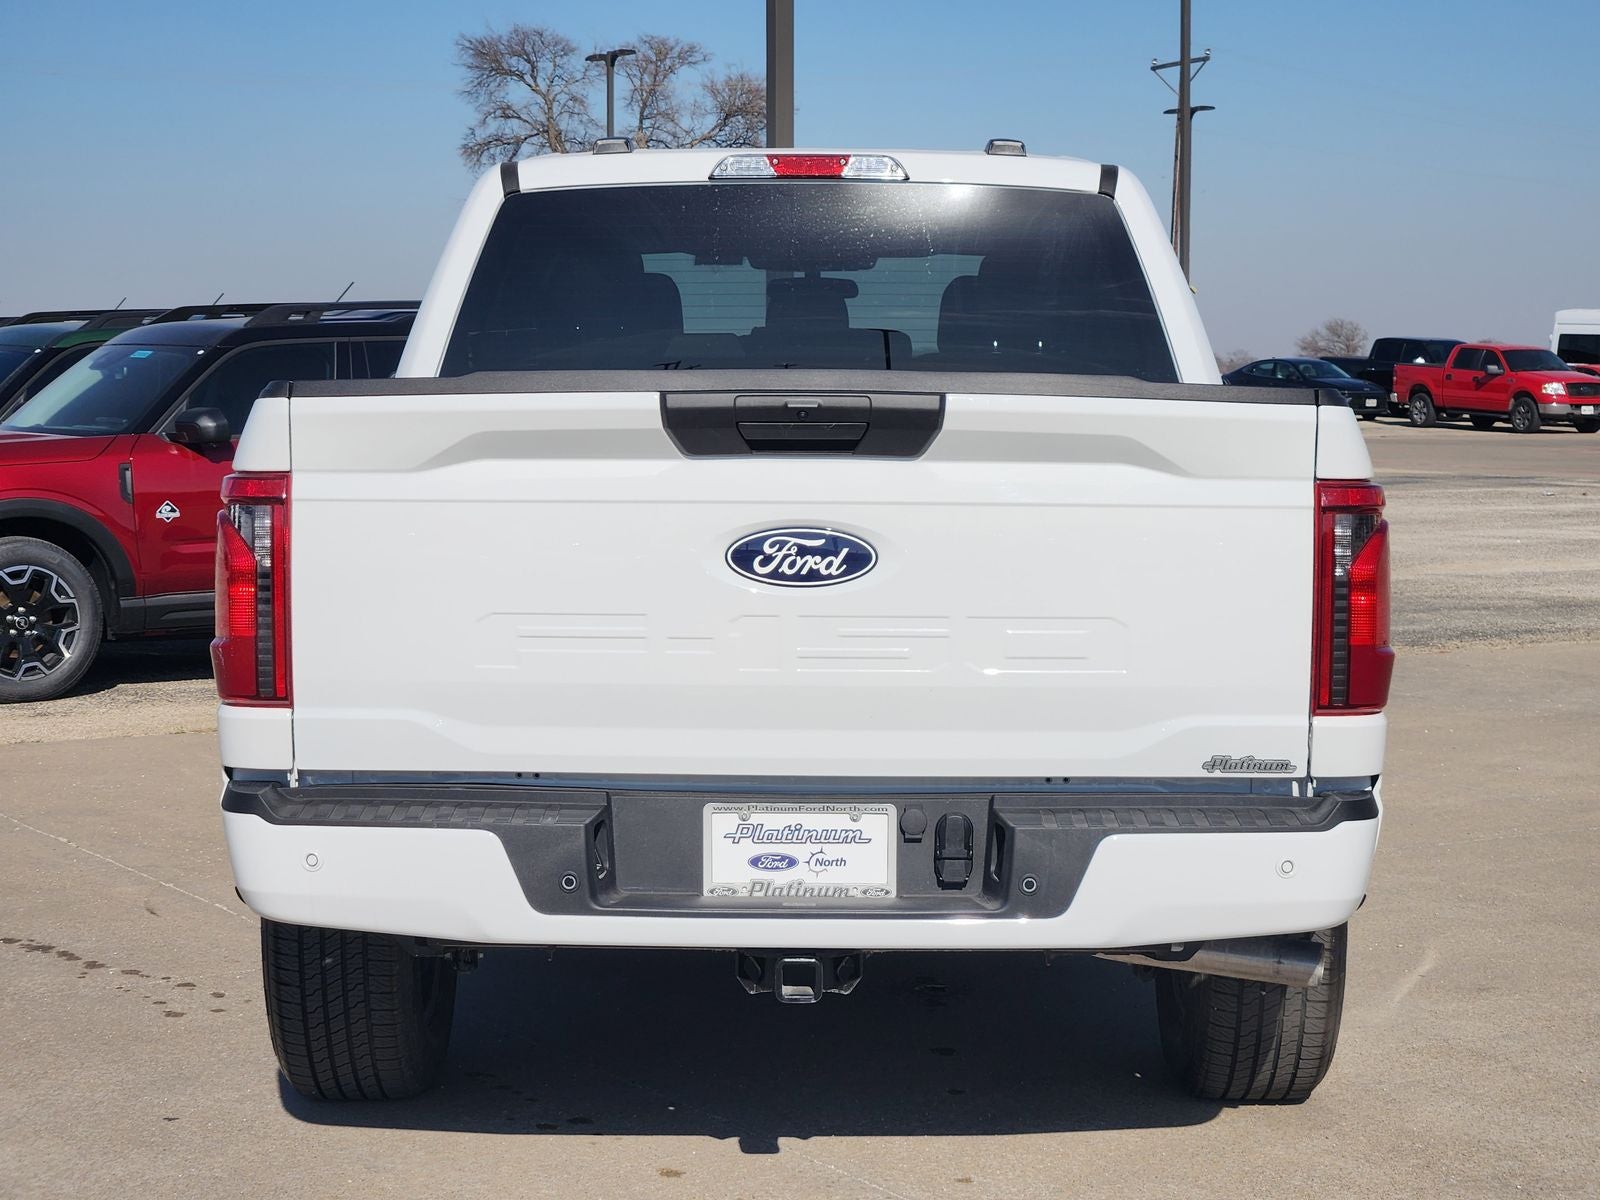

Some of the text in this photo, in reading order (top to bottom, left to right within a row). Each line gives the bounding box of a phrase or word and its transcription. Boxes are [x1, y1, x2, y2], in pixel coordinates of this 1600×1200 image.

[753, 536, 849, 576] Ford
[1202, 755, 1297, 773] Platinum
[712, 804, 888, 812] www.PlatinumFordNorth.com
[724, 823, 872, 844] Platinum
[758, 856, 790, 869] Ford
[814, 857, 847, 868] North
[748, 880, 856, 897] Platinum
